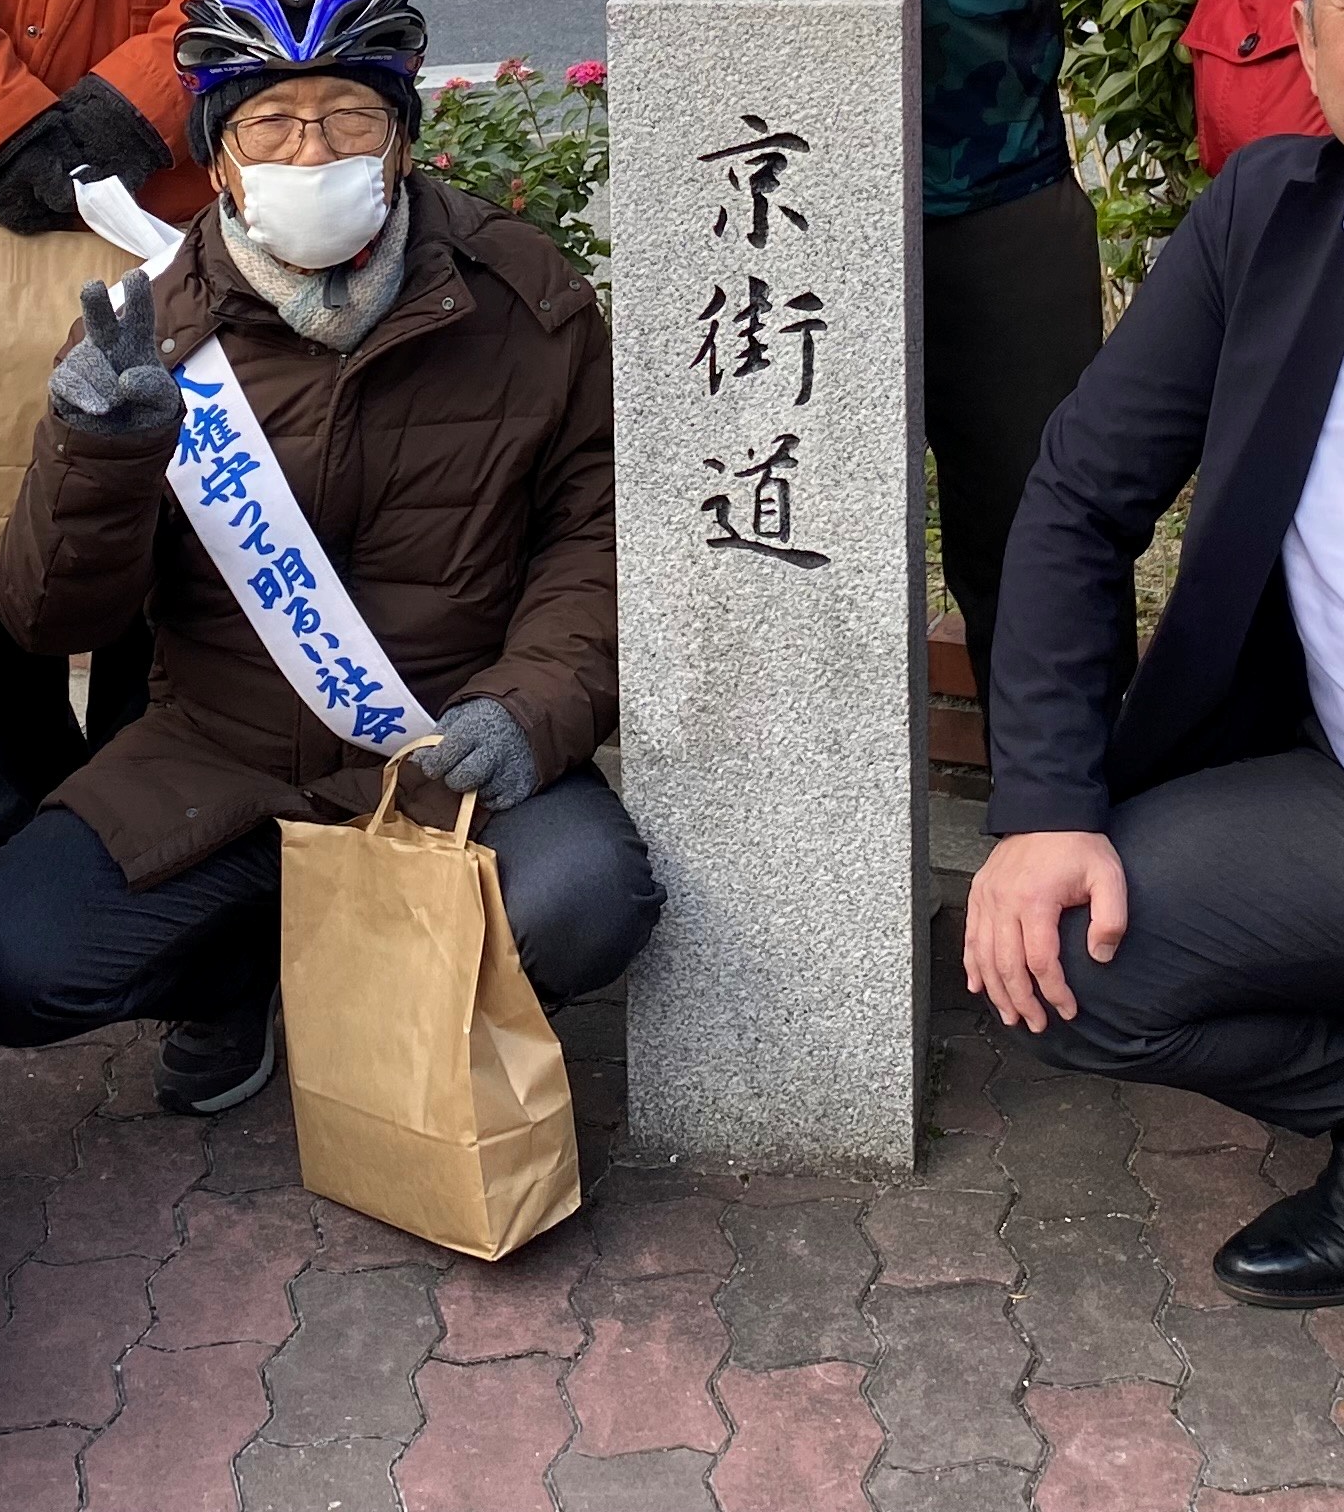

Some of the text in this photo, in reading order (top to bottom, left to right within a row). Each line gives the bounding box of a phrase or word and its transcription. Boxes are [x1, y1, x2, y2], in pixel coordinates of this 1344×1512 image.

[688, 113, 832, 570] 京街道
[170, 361, 408, 746] 人権守って明るい社会
